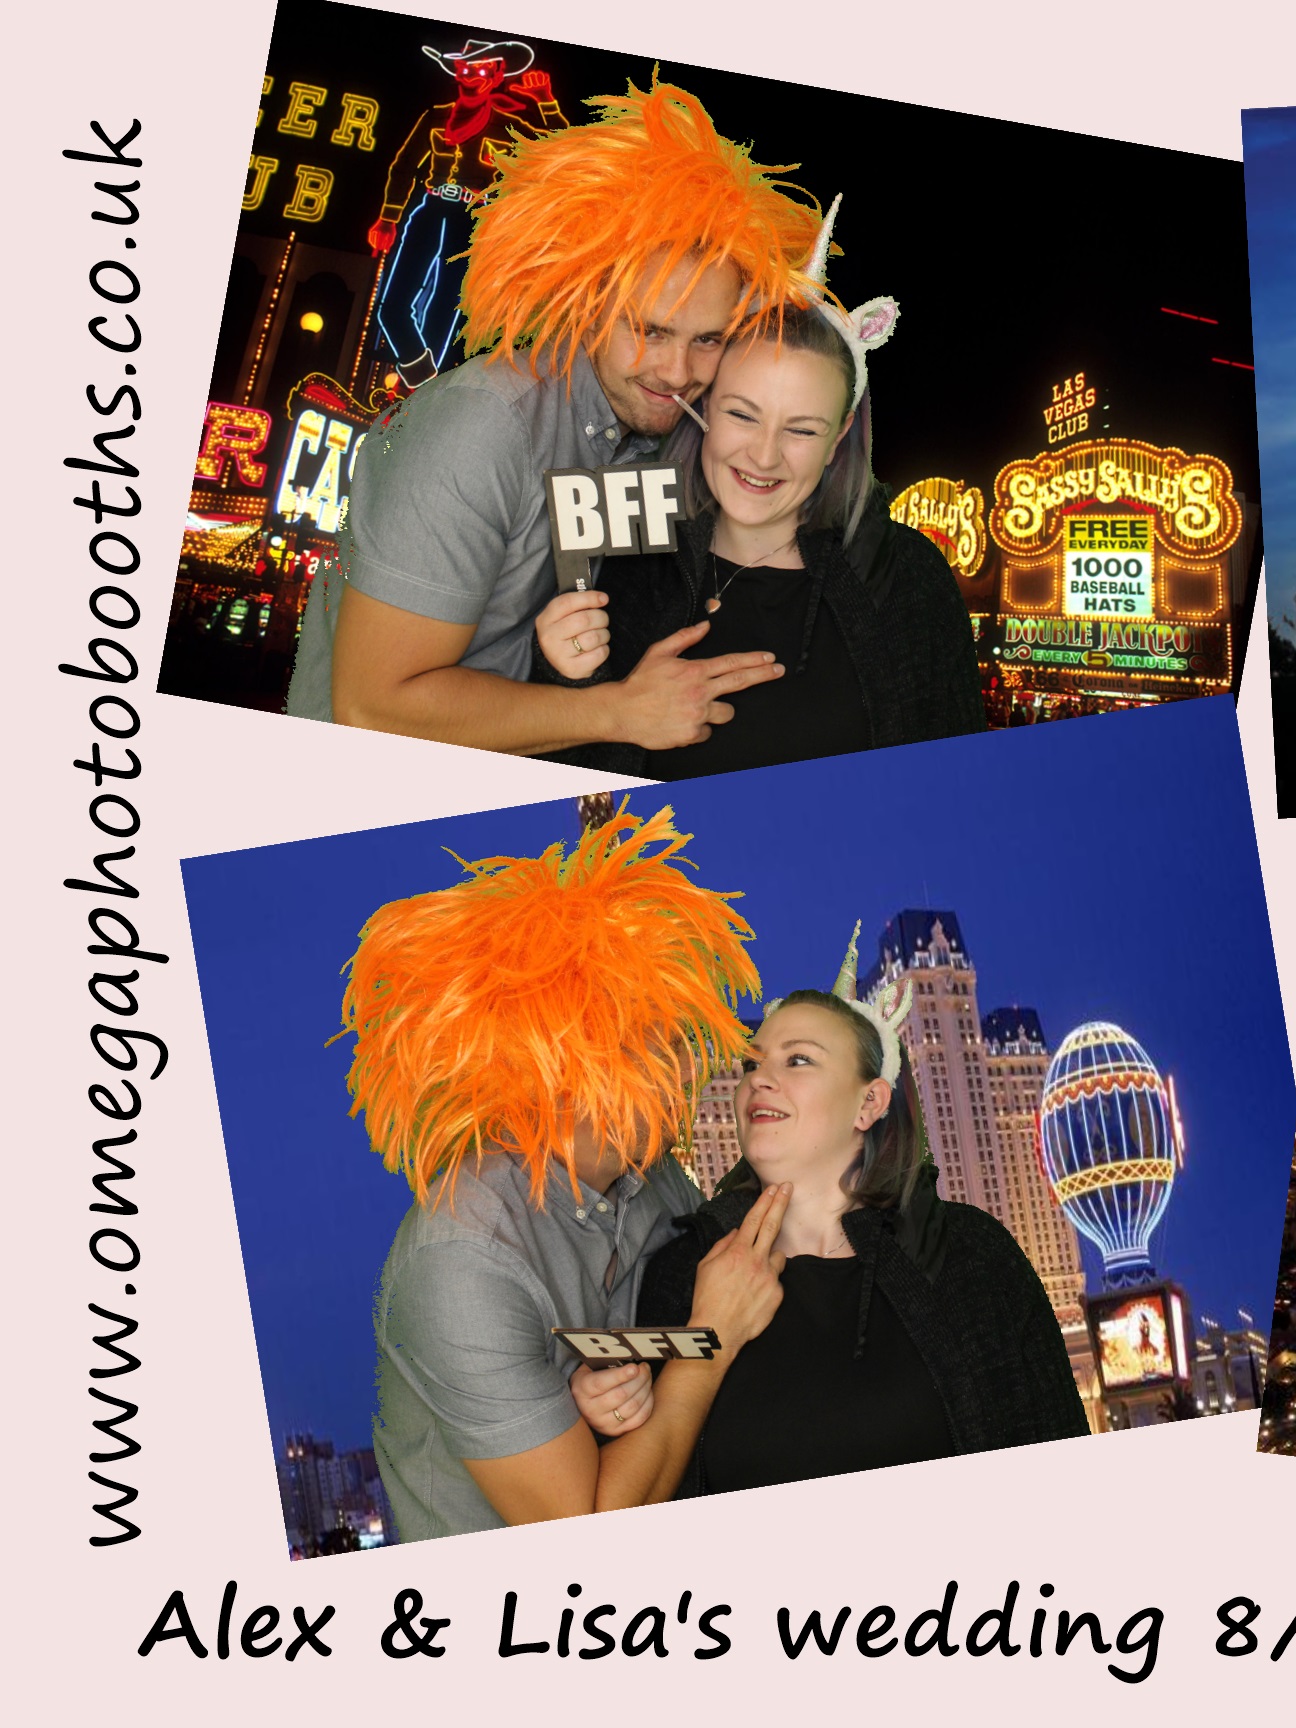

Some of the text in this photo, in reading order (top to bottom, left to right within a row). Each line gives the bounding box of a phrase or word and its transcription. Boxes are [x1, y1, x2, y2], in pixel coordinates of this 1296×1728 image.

[1052, 372, 1085, 402] LAS
[1043, 388, 1096, 425] VEGAS
[1048, 412, 1090, 444] CLUB
[551, 468, 679, 551] BFF
[1069, 520, 1148, 538] FREE
[1069, 540, 1148, 550] EVERYDAY
[1071, 557, 1143, 579] 1000
[1070, 581, 1145, 596] BASEBALL
[1084, 598, 1136, 612] HATS
[1005, 617, 1093, 646] DOUBLE
[1032, 650, 1189, 671] EVERY 5 MINUTES
[1072, 671, 1125, 690] Corona
[563, 1332, 712, 1358] BFF
